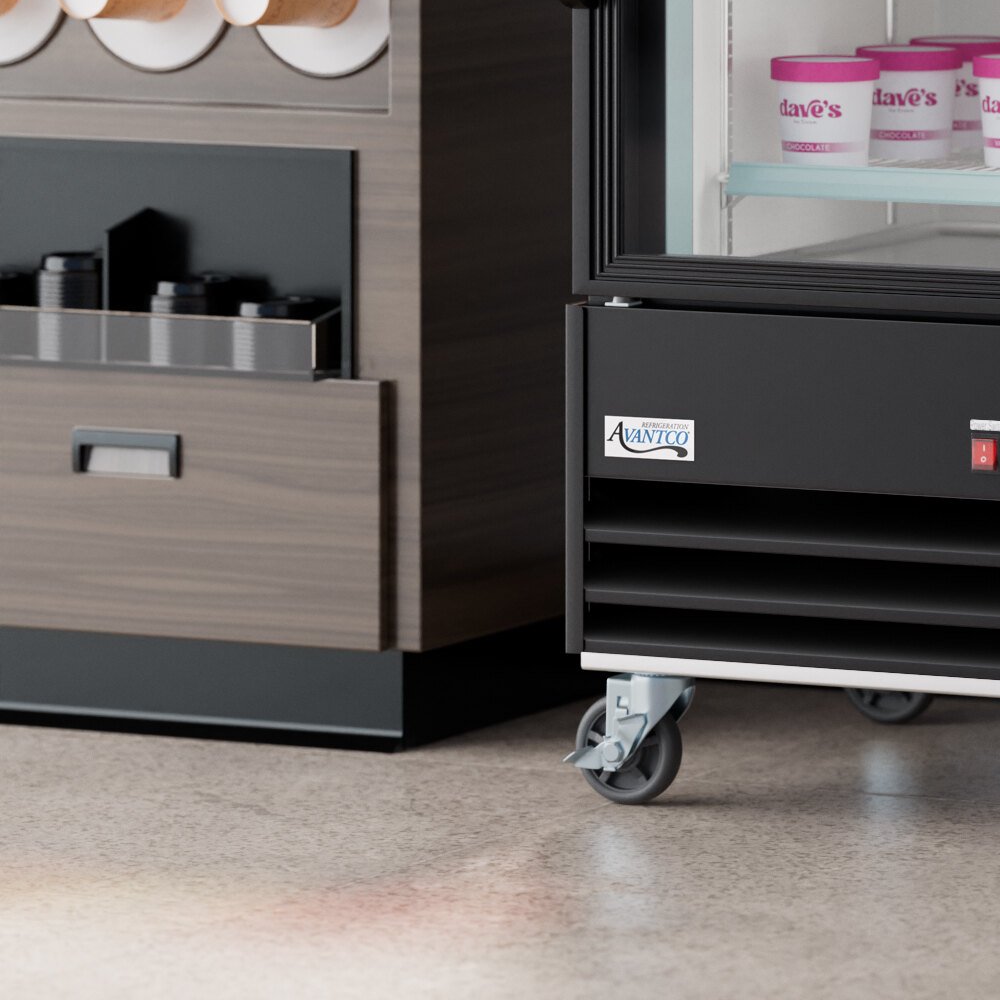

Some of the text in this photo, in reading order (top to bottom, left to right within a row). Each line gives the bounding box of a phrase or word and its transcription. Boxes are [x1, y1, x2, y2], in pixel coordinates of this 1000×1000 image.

[872, 87, 938, 107] dave's
[779, 98, 843, 118] dave's
[879, 130, 926, 139] CHOCOLATE
[786, 143, 831, 152] CHOCOLATE
[642, 421, 690, 430] REFRIGERATION
[607, 421, 690, 451] AVANTCO
